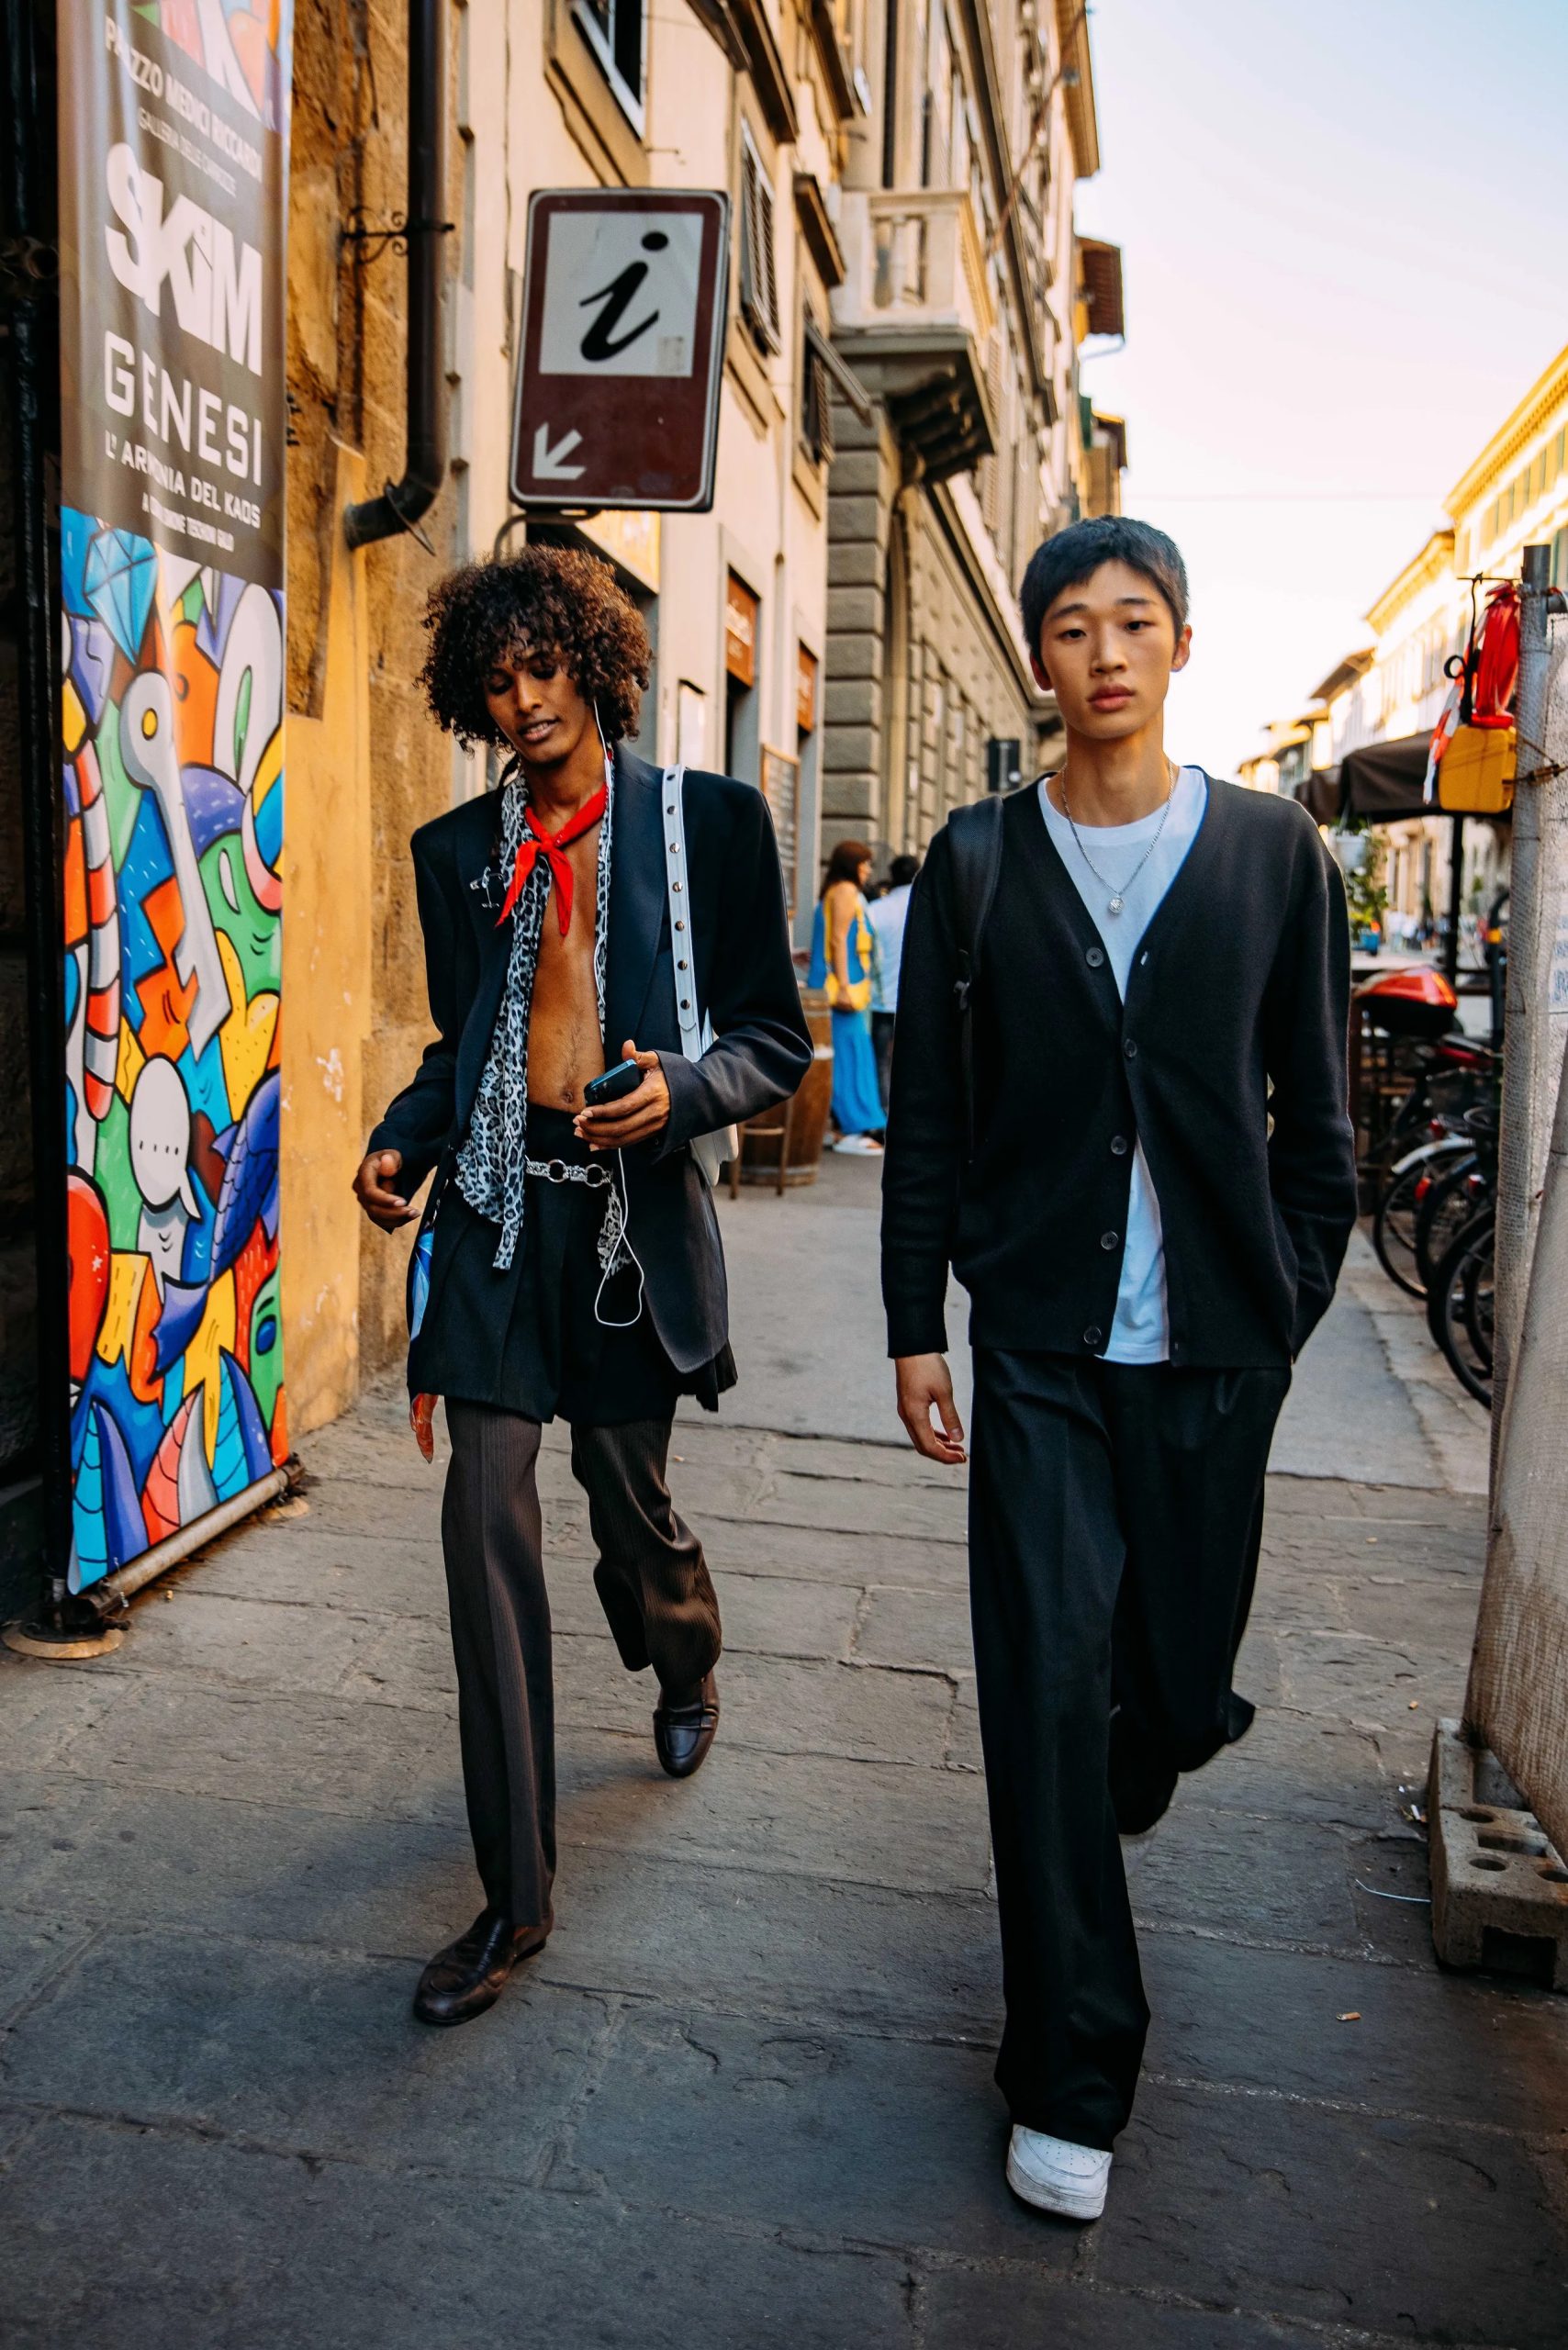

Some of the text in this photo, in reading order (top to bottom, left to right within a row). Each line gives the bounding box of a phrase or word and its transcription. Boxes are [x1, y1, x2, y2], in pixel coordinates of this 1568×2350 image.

[105, 15, 163, 98] PZZO
[105, 330, 262, 487] GENESI
[190, 476, 221, 512] DEL
[224, 491, 262, 529] KAOS
